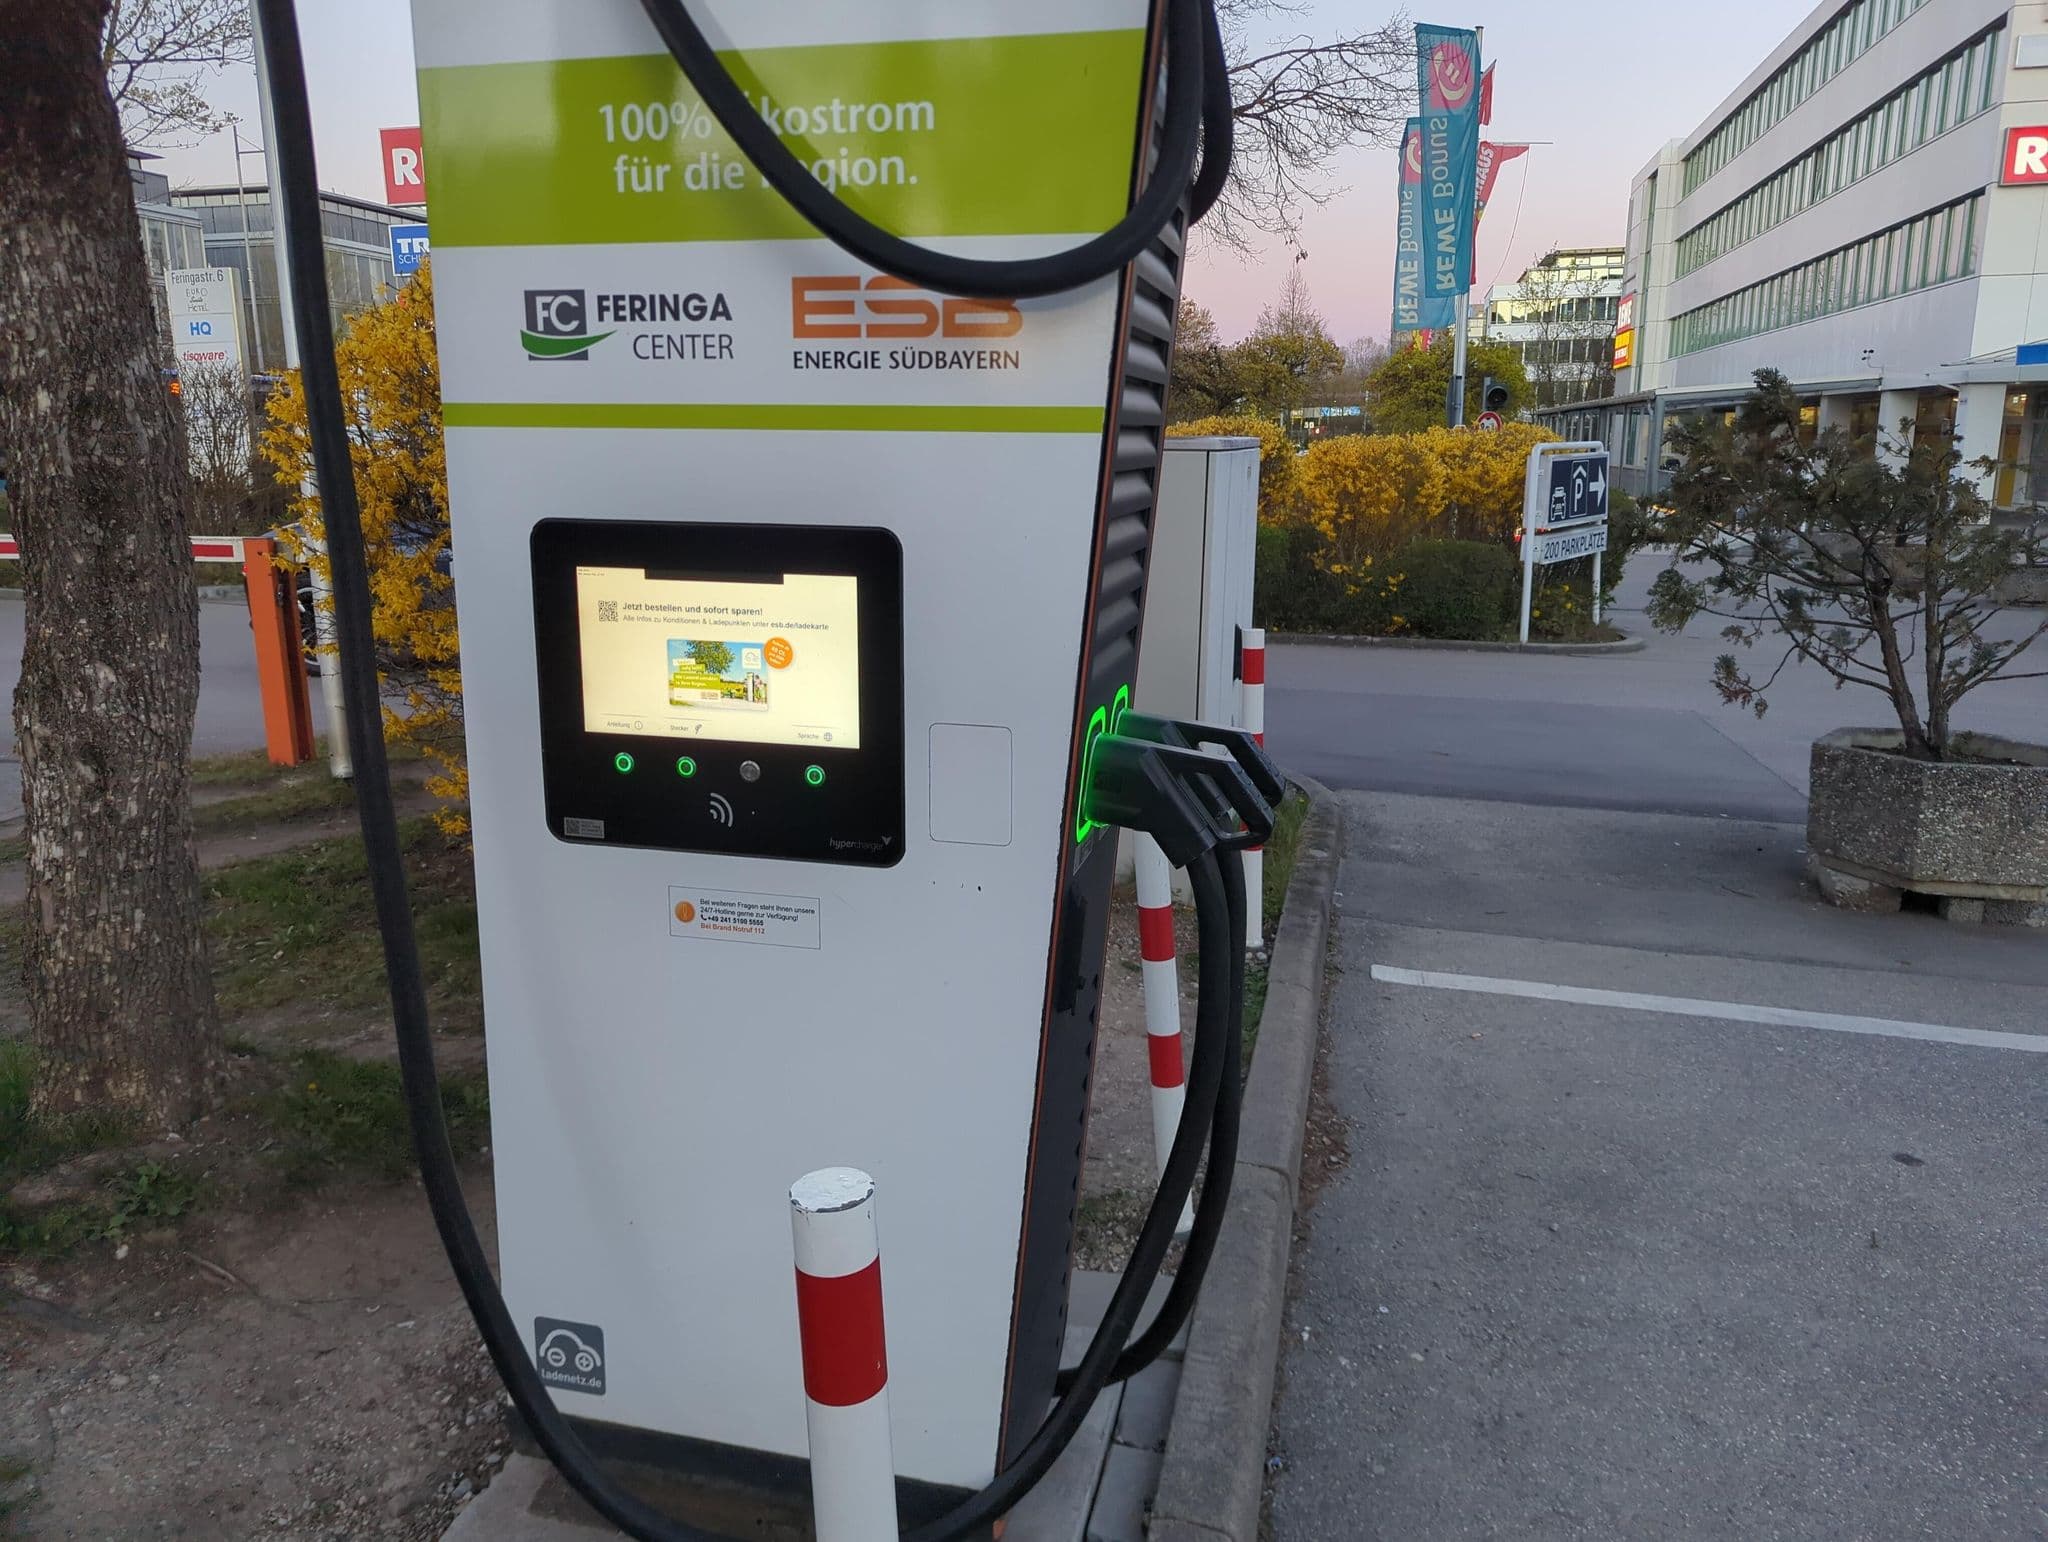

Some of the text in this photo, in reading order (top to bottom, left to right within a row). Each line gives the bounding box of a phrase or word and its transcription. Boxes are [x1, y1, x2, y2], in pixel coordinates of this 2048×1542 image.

[599, 91, 935, 143] 100% kostrom
[391, 147, 426, 186] R
[614, 147, 918, 194] für die gion.
[171, 269, 224, 286] Feringastr. 6
[536, 295, 580, 332] FC
[597, 293, 733, 322] FERINGA
[190, 321, 212, 336] HQ
[183, 350, 225, 361] tisoware
[632, 333, 735, 360] CENTER
[793, 349, 1020, 370] ENERGIE SÜDBAYERN
[1544, 542, 1559, 560] 200
[622, 602, 763, 616] Jetzt bestellen und sofort sparen!
[737, 901, 759, 911] Fragen
[737, 910, 755, 918] gerne
